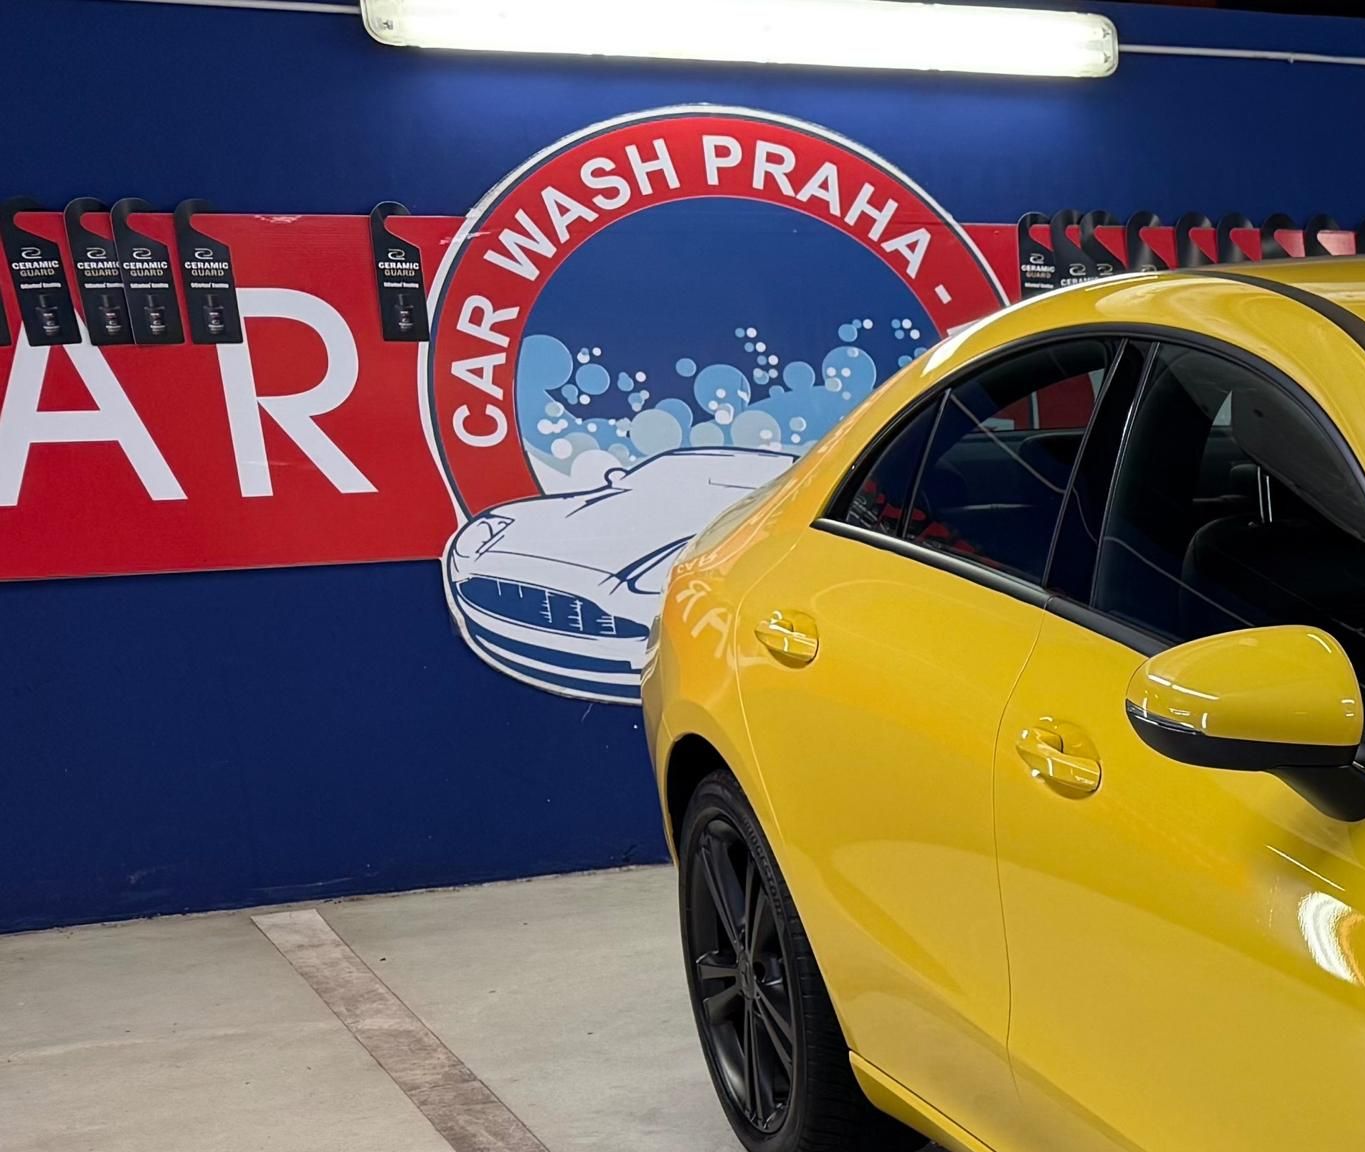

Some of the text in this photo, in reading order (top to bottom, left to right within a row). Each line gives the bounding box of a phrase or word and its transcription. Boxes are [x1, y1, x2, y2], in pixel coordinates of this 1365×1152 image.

[484, 137, 682, 283] WASH
[701, 134, 933, 279] PRAHA
[12, 260, 60, 270] CERAMIC
[123, 261, 168, 270] CERAMIC
[184, 261, 229, 270] CERAMIC
[378, 261, 420, 270] CERAMIC
[1021, 264, 1056, 273] CERAMIC
[20, 268, 55, 278] GUARD
[130, 269, 164, 277] GUARD
[191, 269, 225, 277] GUARD
[384, 269, 416, 277] GUARD
[450, 294, 520, 448] CAR
